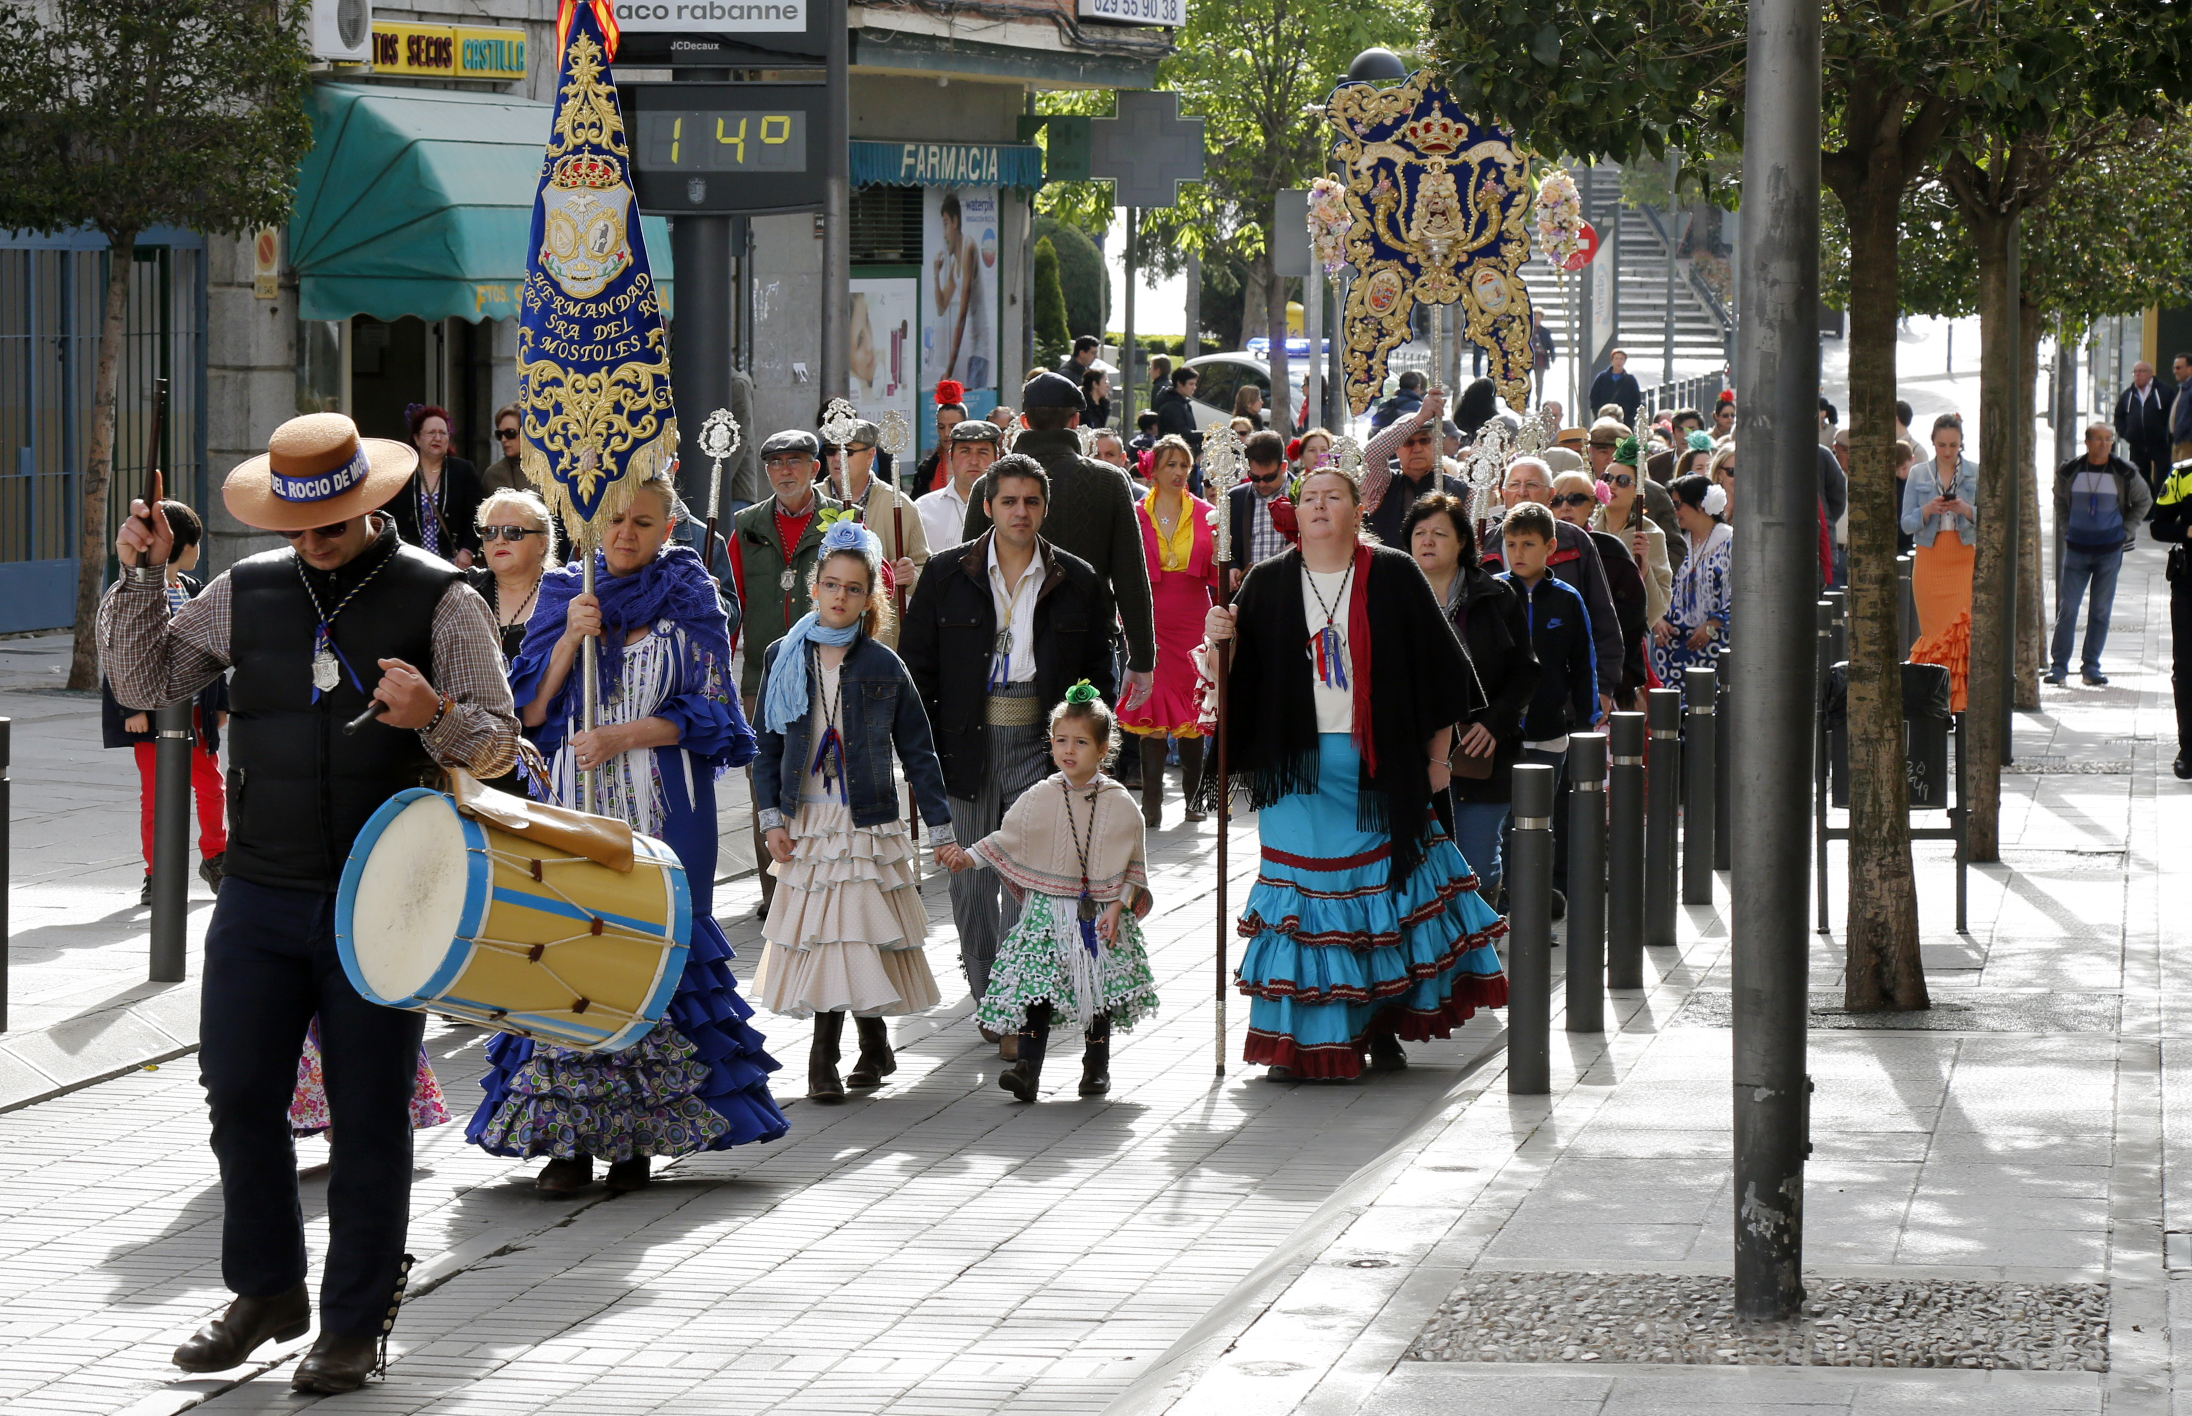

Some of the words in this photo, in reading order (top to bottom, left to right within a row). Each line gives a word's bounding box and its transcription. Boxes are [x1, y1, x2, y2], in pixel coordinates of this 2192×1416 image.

[612, 4, 669, 20] aco
[676, 1, 799, 20] rabanne
[1122, 0, 1138, 15] 55
[1142, 0, 1158, 18] 90
[1162, 0, 1177, 20] 38
[372, 32, 399, 65] TOS
[407, 35, 452, 68] SECOS
[463, 38, 525, 71] CASTILLA
[670, 41, 720, 51] JCDecaux
[901, 143, 998, 181] FARMACIA
[533, 271, 650, 319] HERMANDAD
[545, 314, 580, 341] SRA
[593, 316, 634, 342] DEL
[638, 290, 659, 319] RO
[539, 335, 641, 361] MOSTOLES
[272, 474, 287, 496] DEL
[287, 478, 331, 498] ROCIO
[333, 469, 350, 491] DE
[349, 453, 366, 482] MÓS
